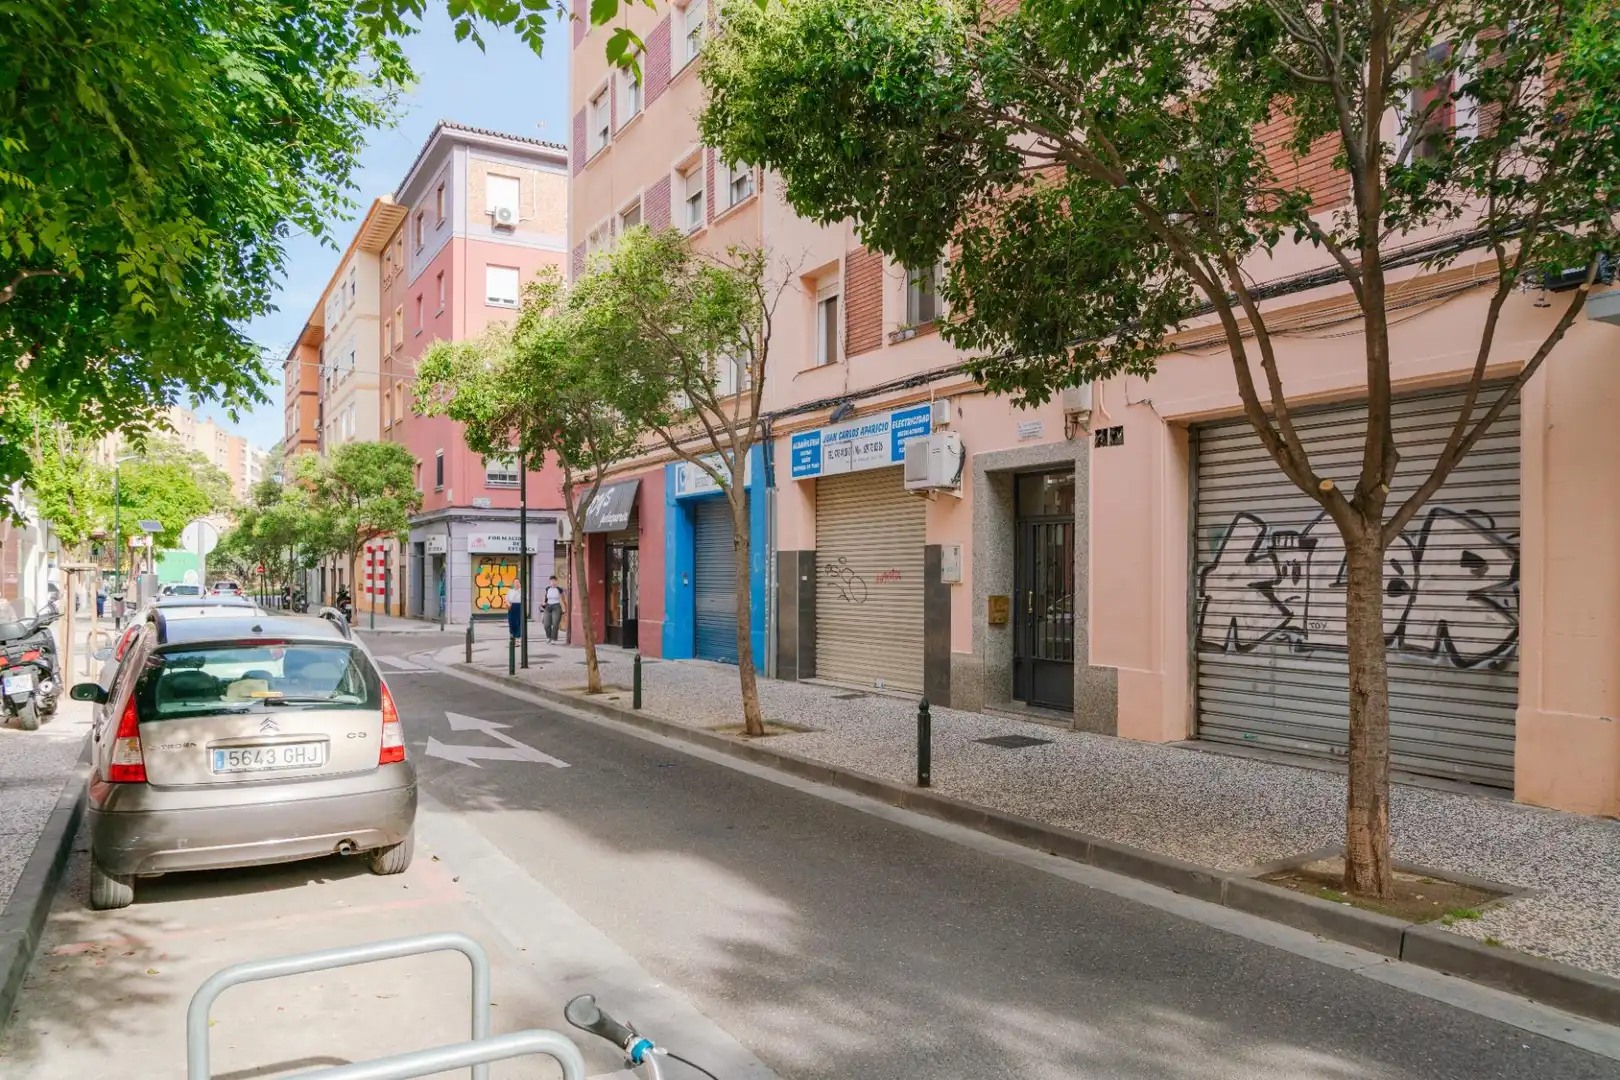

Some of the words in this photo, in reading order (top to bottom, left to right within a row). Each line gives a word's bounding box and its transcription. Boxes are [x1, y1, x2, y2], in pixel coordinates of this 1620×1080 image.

[892, 414, 930, 430] ELECTRICIDAD
[823, 432, 838, 444] JUAN
[838, 427, 860, 440] CARLOS
[860, 422, 889, 437] APARICIO
[346, 731, 368, 739] C3
[228, 750, 277, 767] 5643
[283, 746, 317, 764] GHJ
